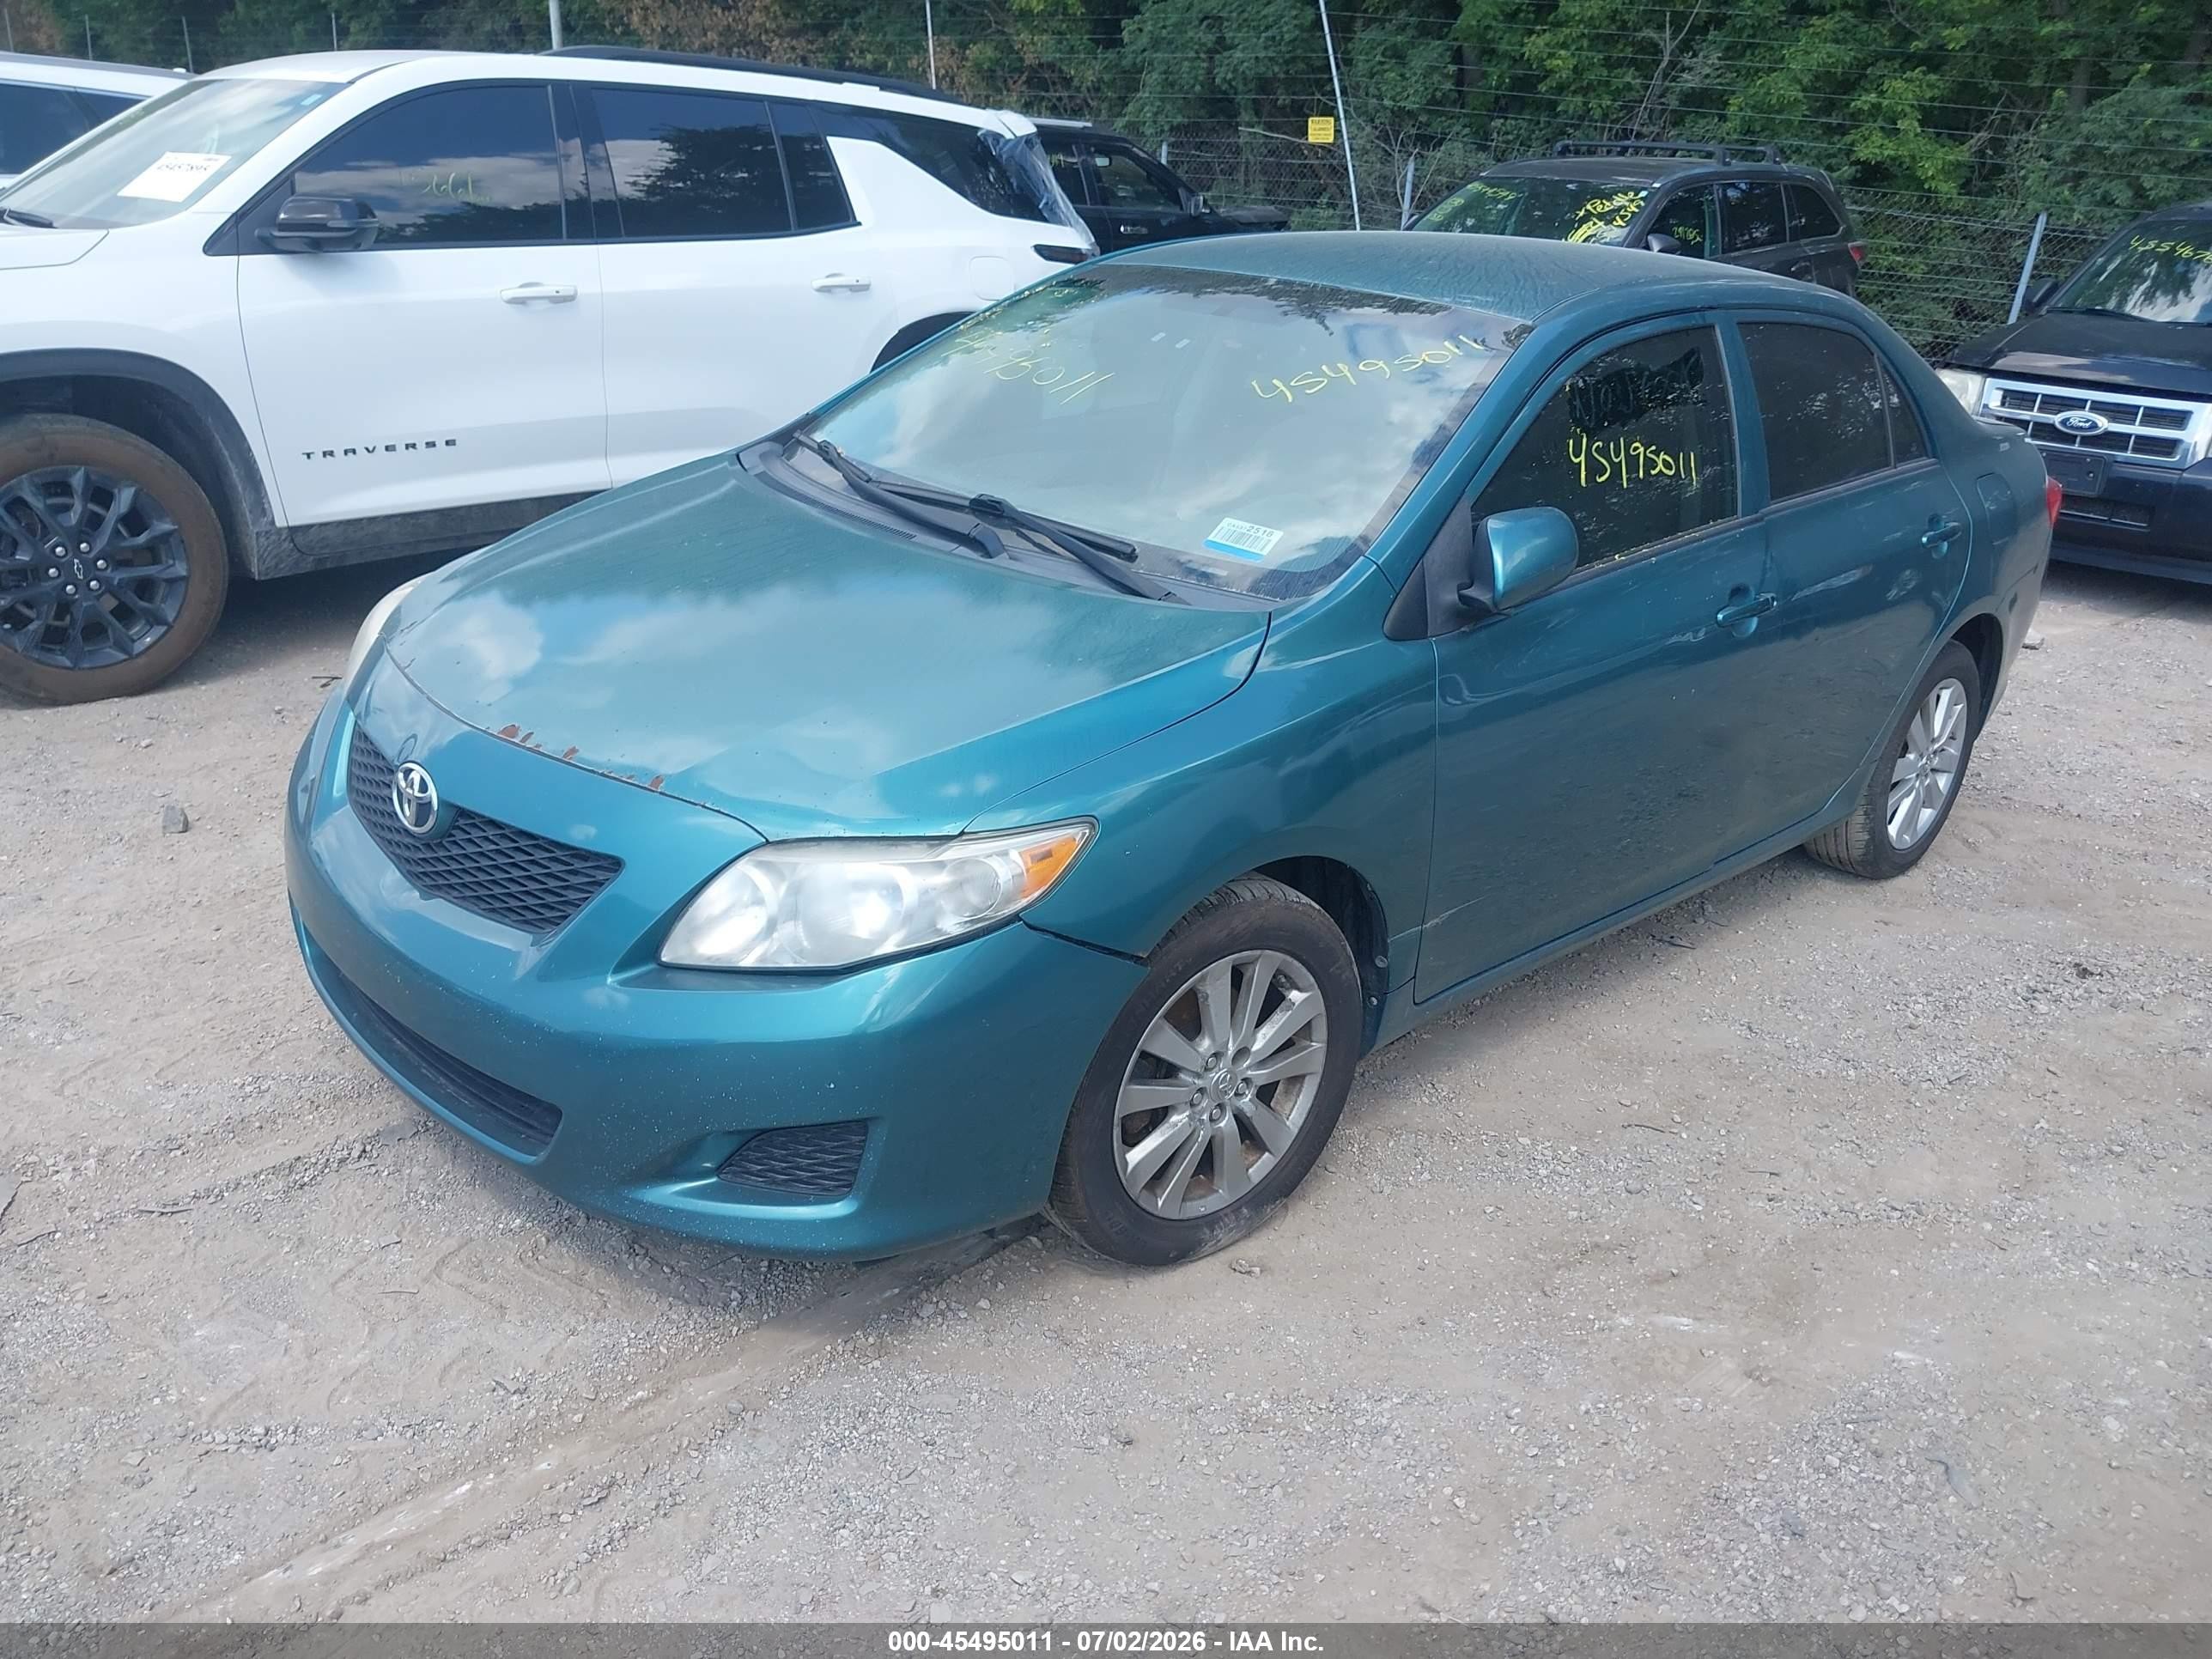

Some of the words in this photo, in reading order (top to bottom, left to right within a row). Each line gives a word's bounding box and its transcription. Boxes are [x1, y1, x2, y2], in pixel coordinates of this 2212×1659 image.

[1250, 334, 1485, 403] 45495011
[2066, 417, 2093, 428] Ford
[302, 439, 457, 459] TRAVERSE
[1569, 433, 1698, 489] 45495011
